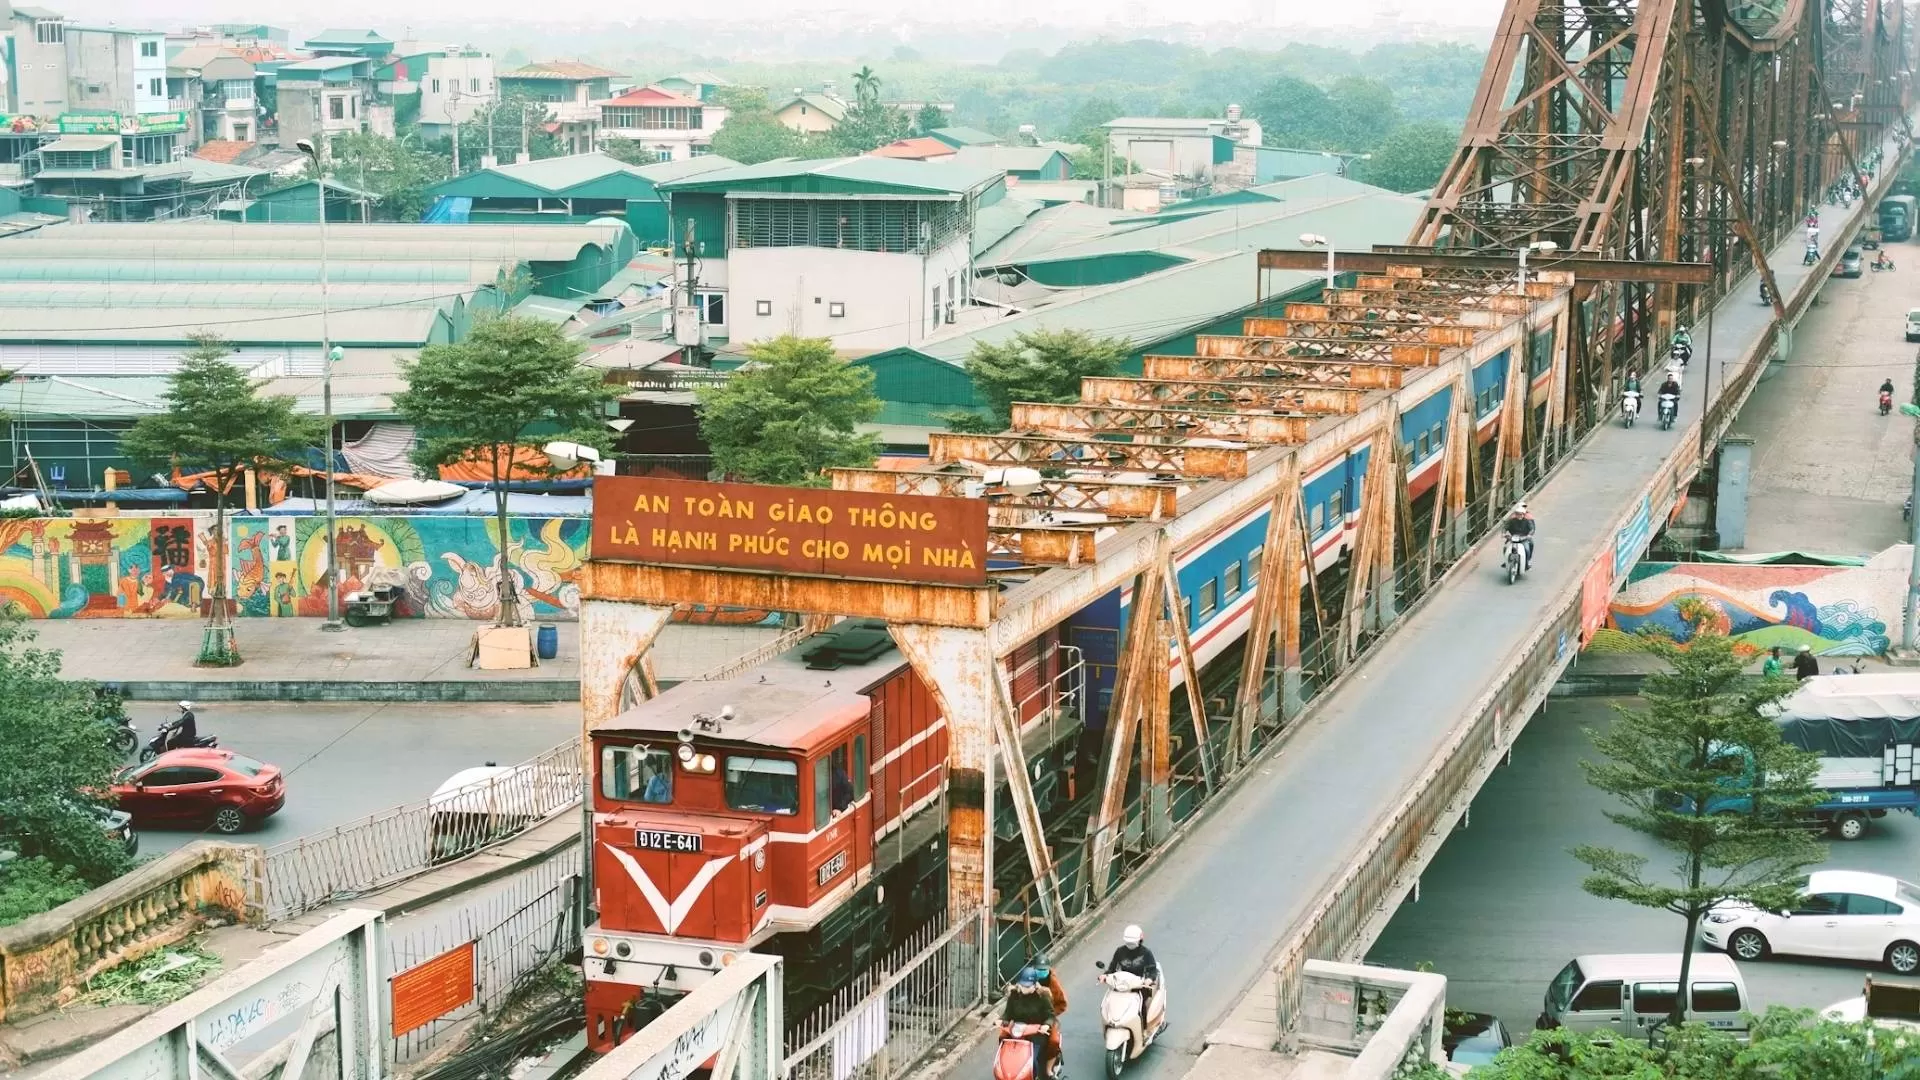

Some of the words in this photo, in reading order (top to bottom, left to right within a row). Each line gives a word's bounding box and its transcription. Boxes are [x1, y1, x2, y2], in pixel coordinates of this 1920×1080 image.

[633, 494, 670, 514] AN
[684, 492, 755, 520] TOÀN
[847, 502, 938, 531] THÔNG
[610, 519, 640, 546] LÀ
[651, 528, 718, 554] HẠNH
[729, 527, 791, 556] PHÚC
[801, 539, 850, 560] CHO
[923, 539, 977, 569] NHÀ
